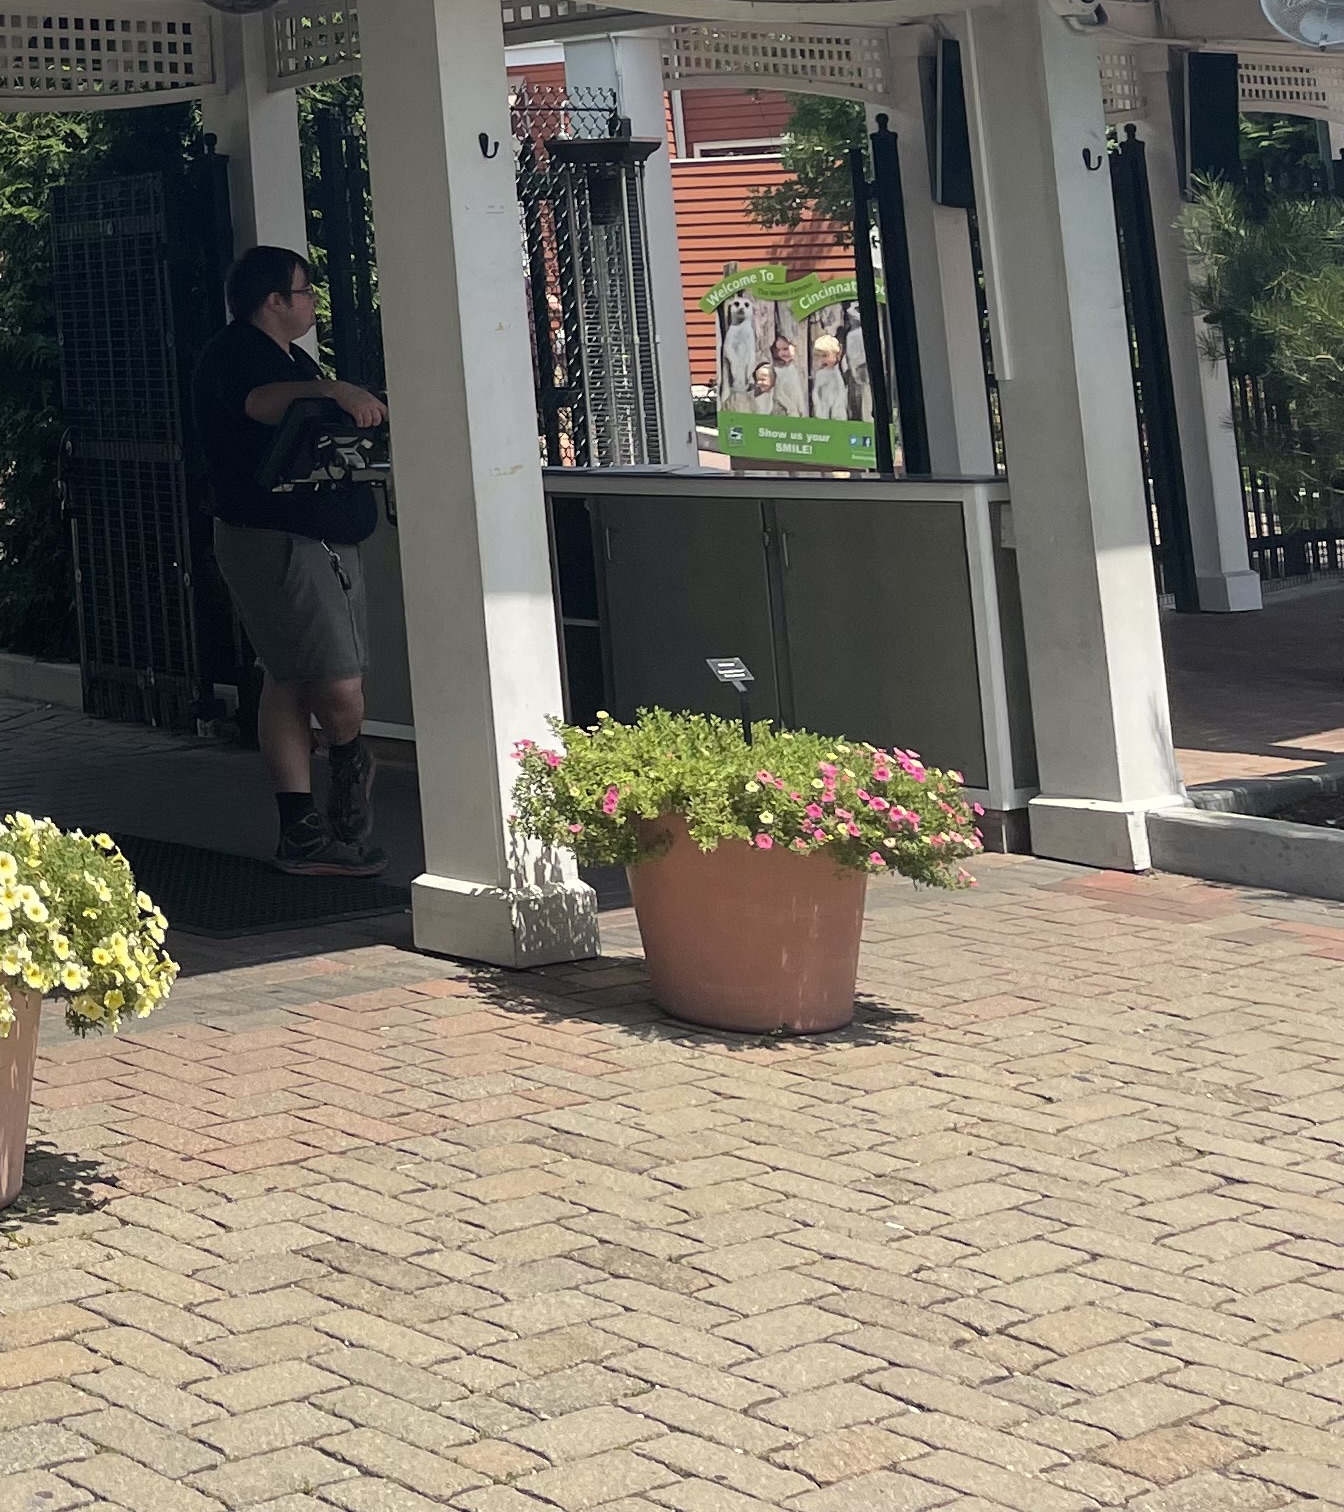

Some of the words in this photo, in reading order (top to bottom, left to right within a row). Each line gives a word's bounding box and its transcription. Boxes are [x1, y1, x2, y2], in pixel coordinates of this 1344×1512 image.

[706, 273, 757, 306] Welcome
[760, 269, 774, 281] To
[799, 281, 857, 310] Cincinnat
[758, 427, 787, 439] Show
[790, 431, 803, 440] us
[806, 433, 830, 443] your
[775, 442, 813, 455] SMILE!
